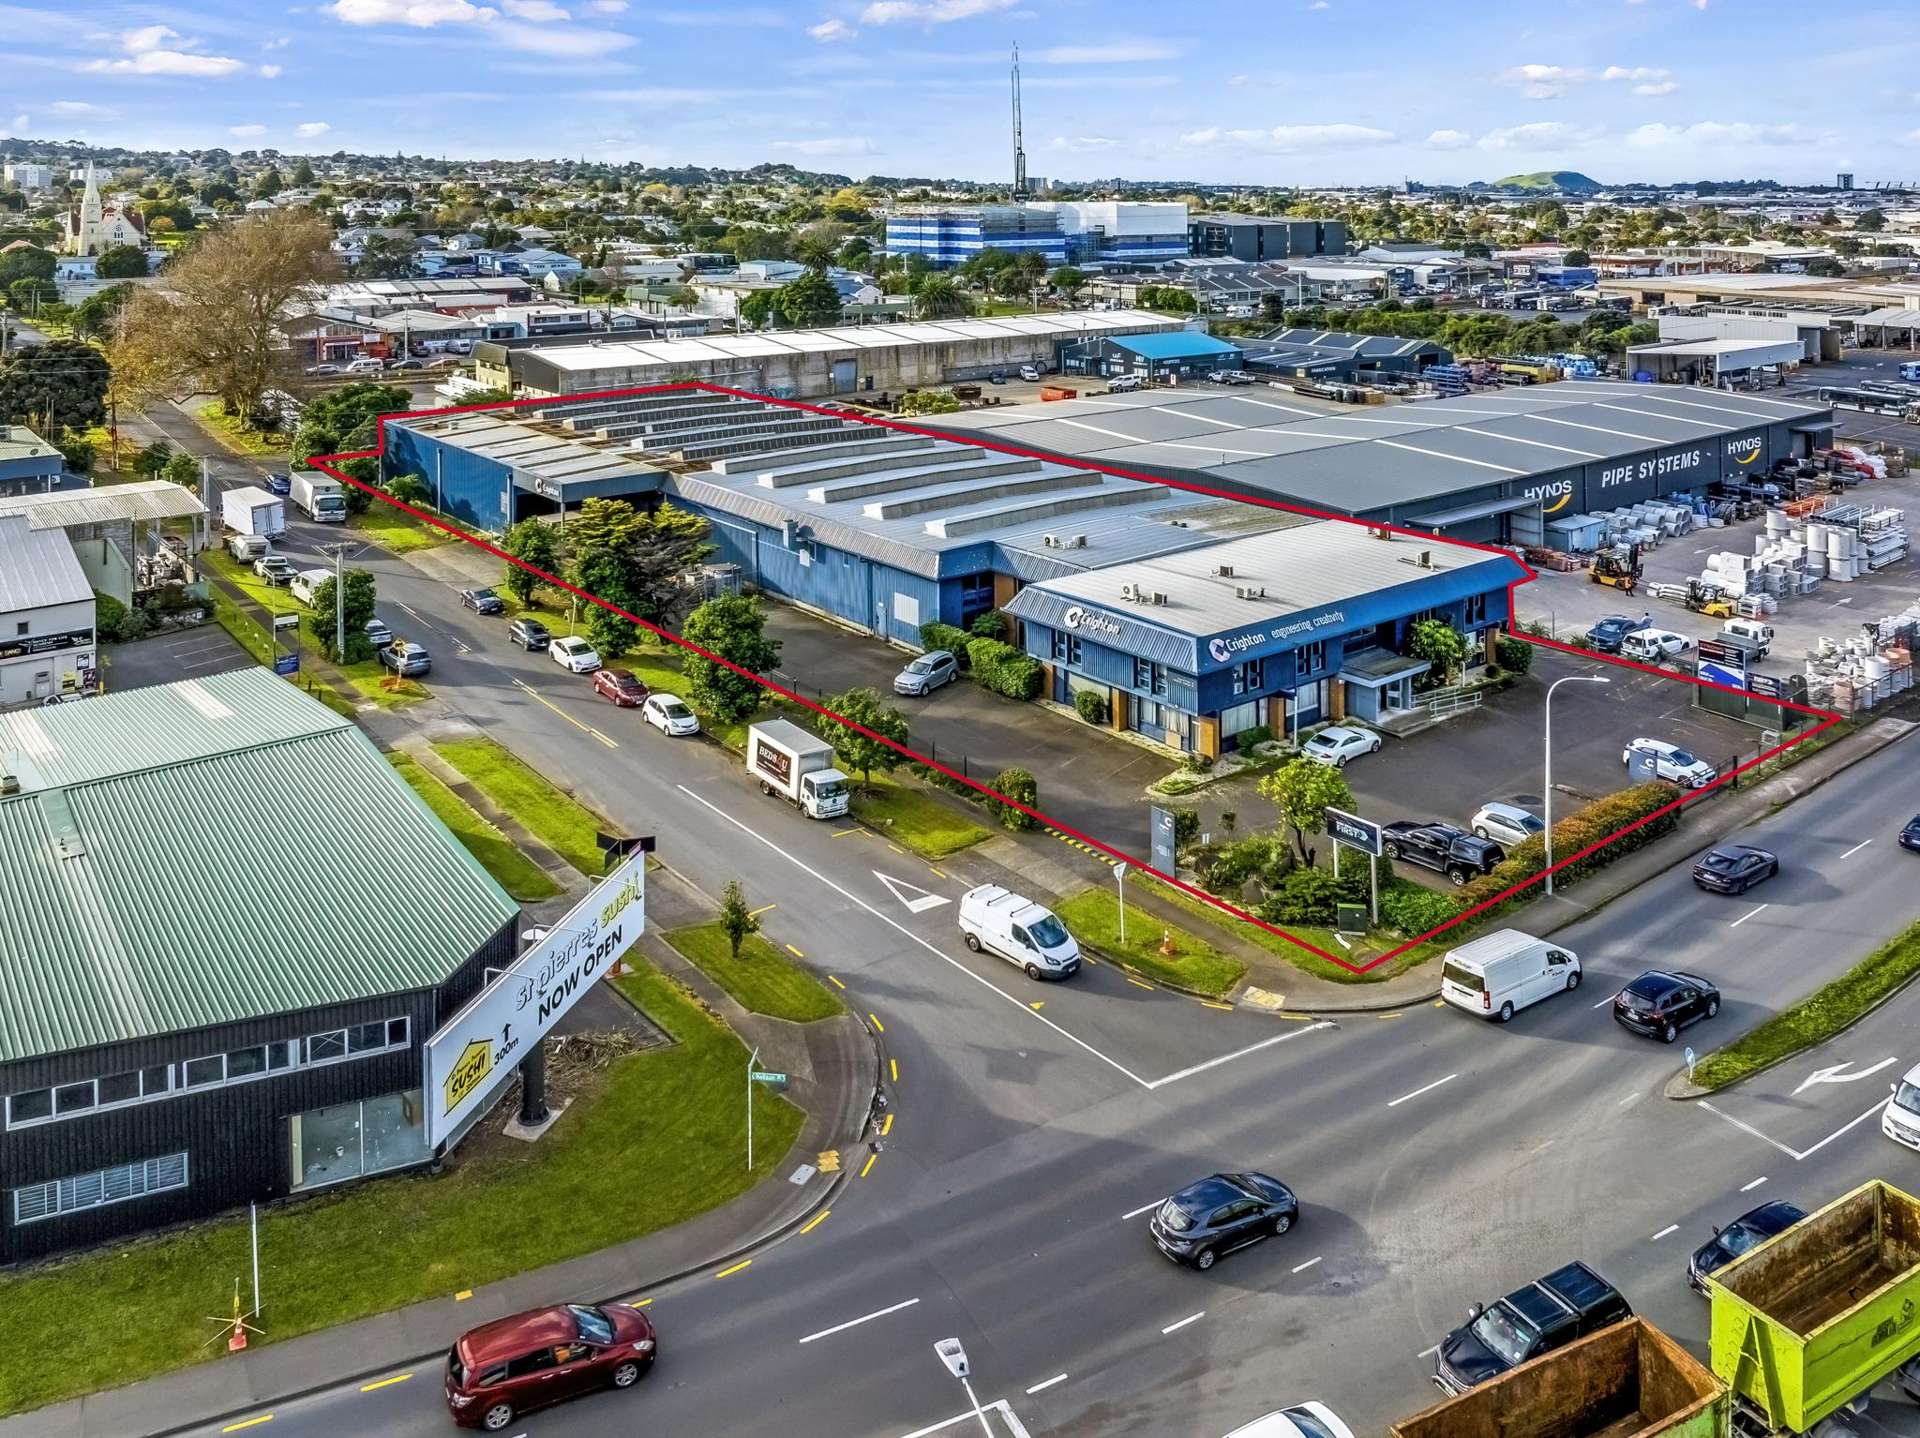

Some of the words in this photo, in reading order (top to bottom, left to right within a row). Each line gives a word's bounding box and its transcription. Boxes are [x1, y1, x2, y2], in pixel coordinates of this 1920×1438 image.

[1727, 436, 1762, 455] HYNDS
[1601, 465, 1633, 488] PIPE
[1639, 450, 1700, 479] SYSTEMS
[1524, 479, 1572, 500] HYNDS
[1080, 612, 1120, 634] Crighton
[1225, 633, 1266, 651] Crighton
[1270, 620, 1314, 639] engineering
[1312, 610, 1345, 627] creativity
[538, 967, 580, 1025] NOW
[583, 924, 623, 977] OPEN
[494, 1037, 519, 1065] 300m
[451, 1052, 486, 1098] SUSHI
